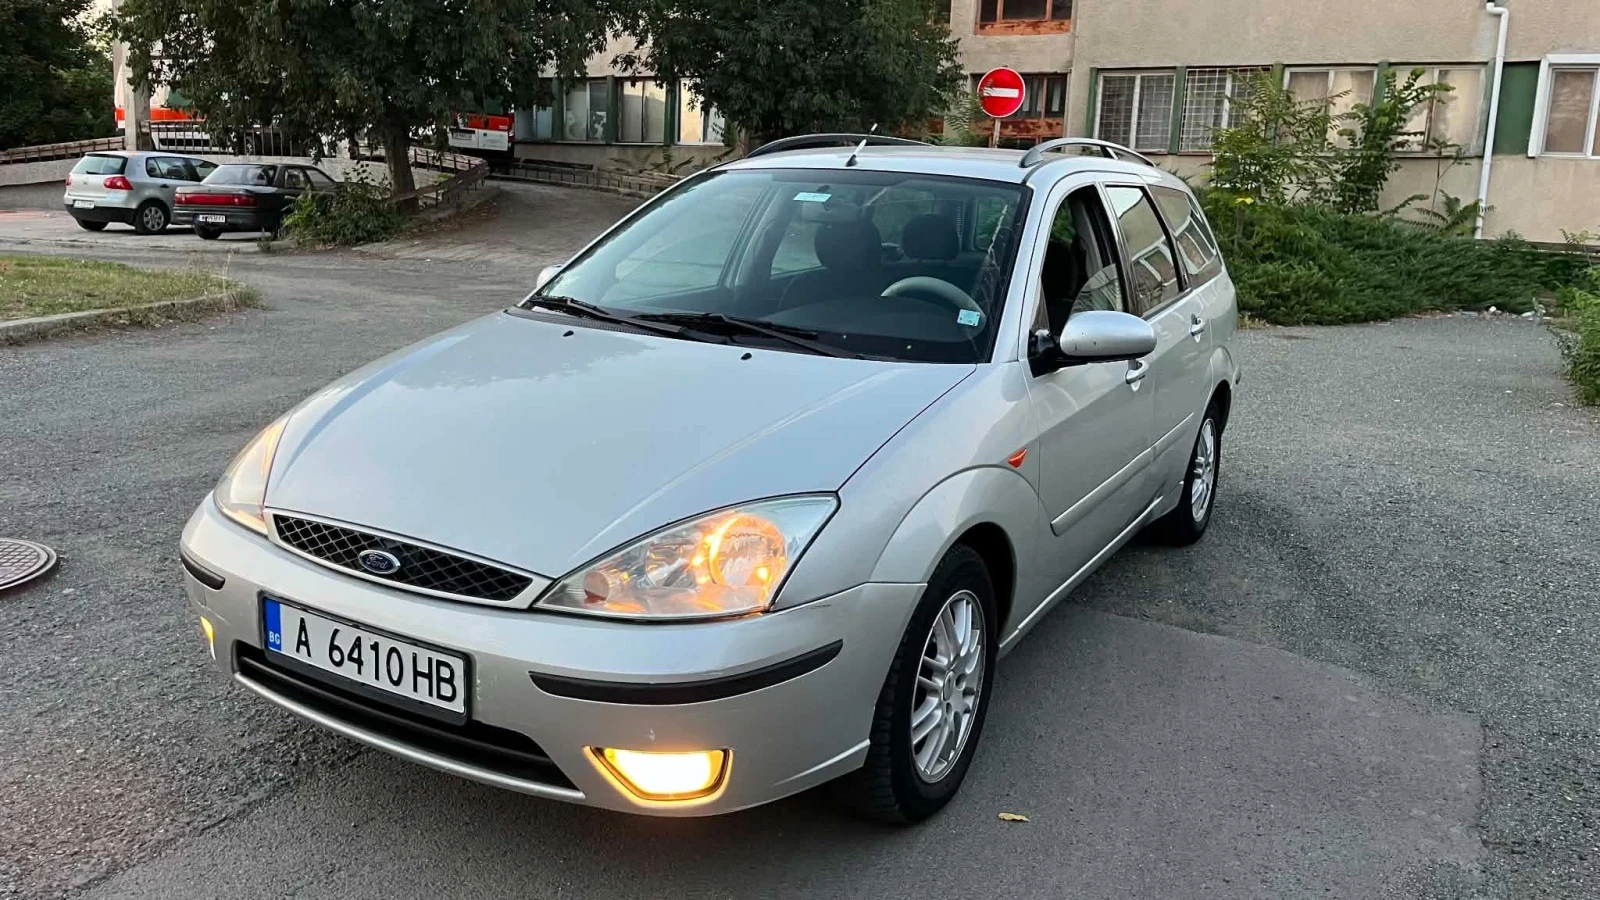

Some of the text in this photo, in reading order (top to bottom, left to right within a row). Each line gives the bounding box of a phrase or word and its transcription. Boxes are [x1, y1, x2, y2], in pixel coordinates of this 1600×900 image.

[365, 553, 389, 570] Ford
[268, 630, 281, 645] BG
[295, 616, 457, 703] A 6410 HB
